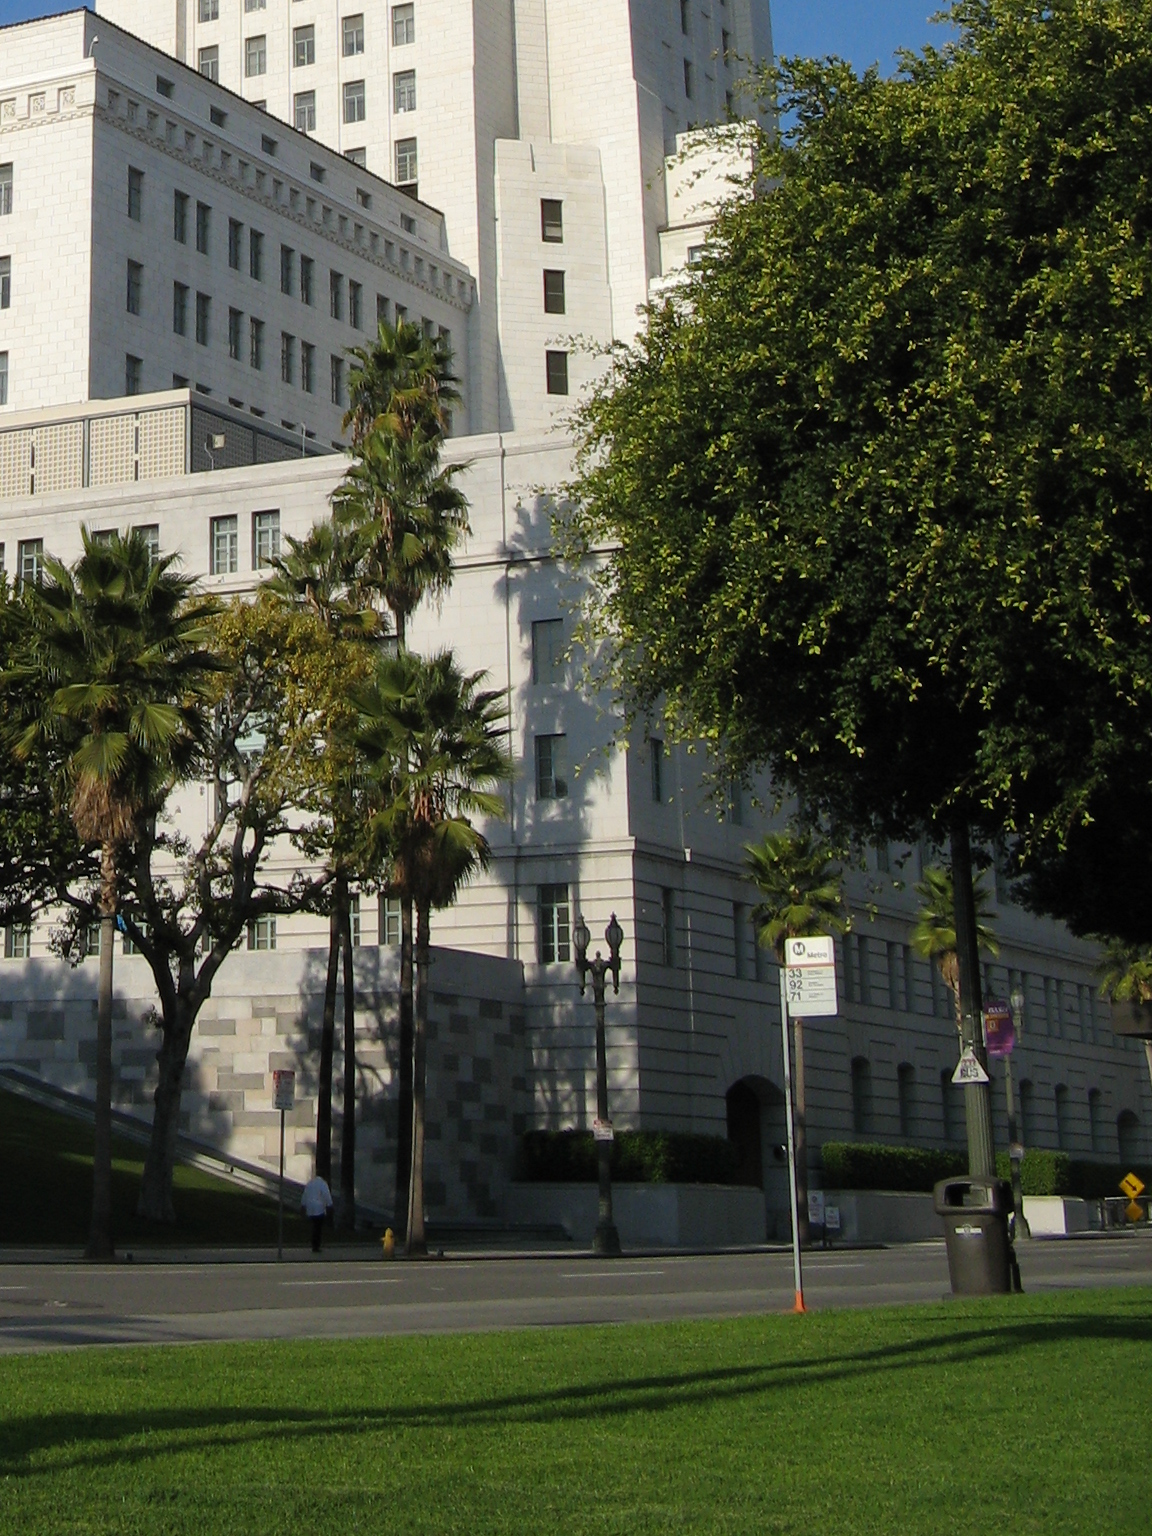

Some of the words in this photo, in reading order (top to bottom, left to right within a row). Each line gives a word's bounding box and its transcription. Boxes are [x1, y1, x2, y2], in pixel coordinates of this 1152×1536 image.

[788, 968, 802, 978] 33
[789, 980, 803, 990] 92
[790, 992, 801, 1002] 71
